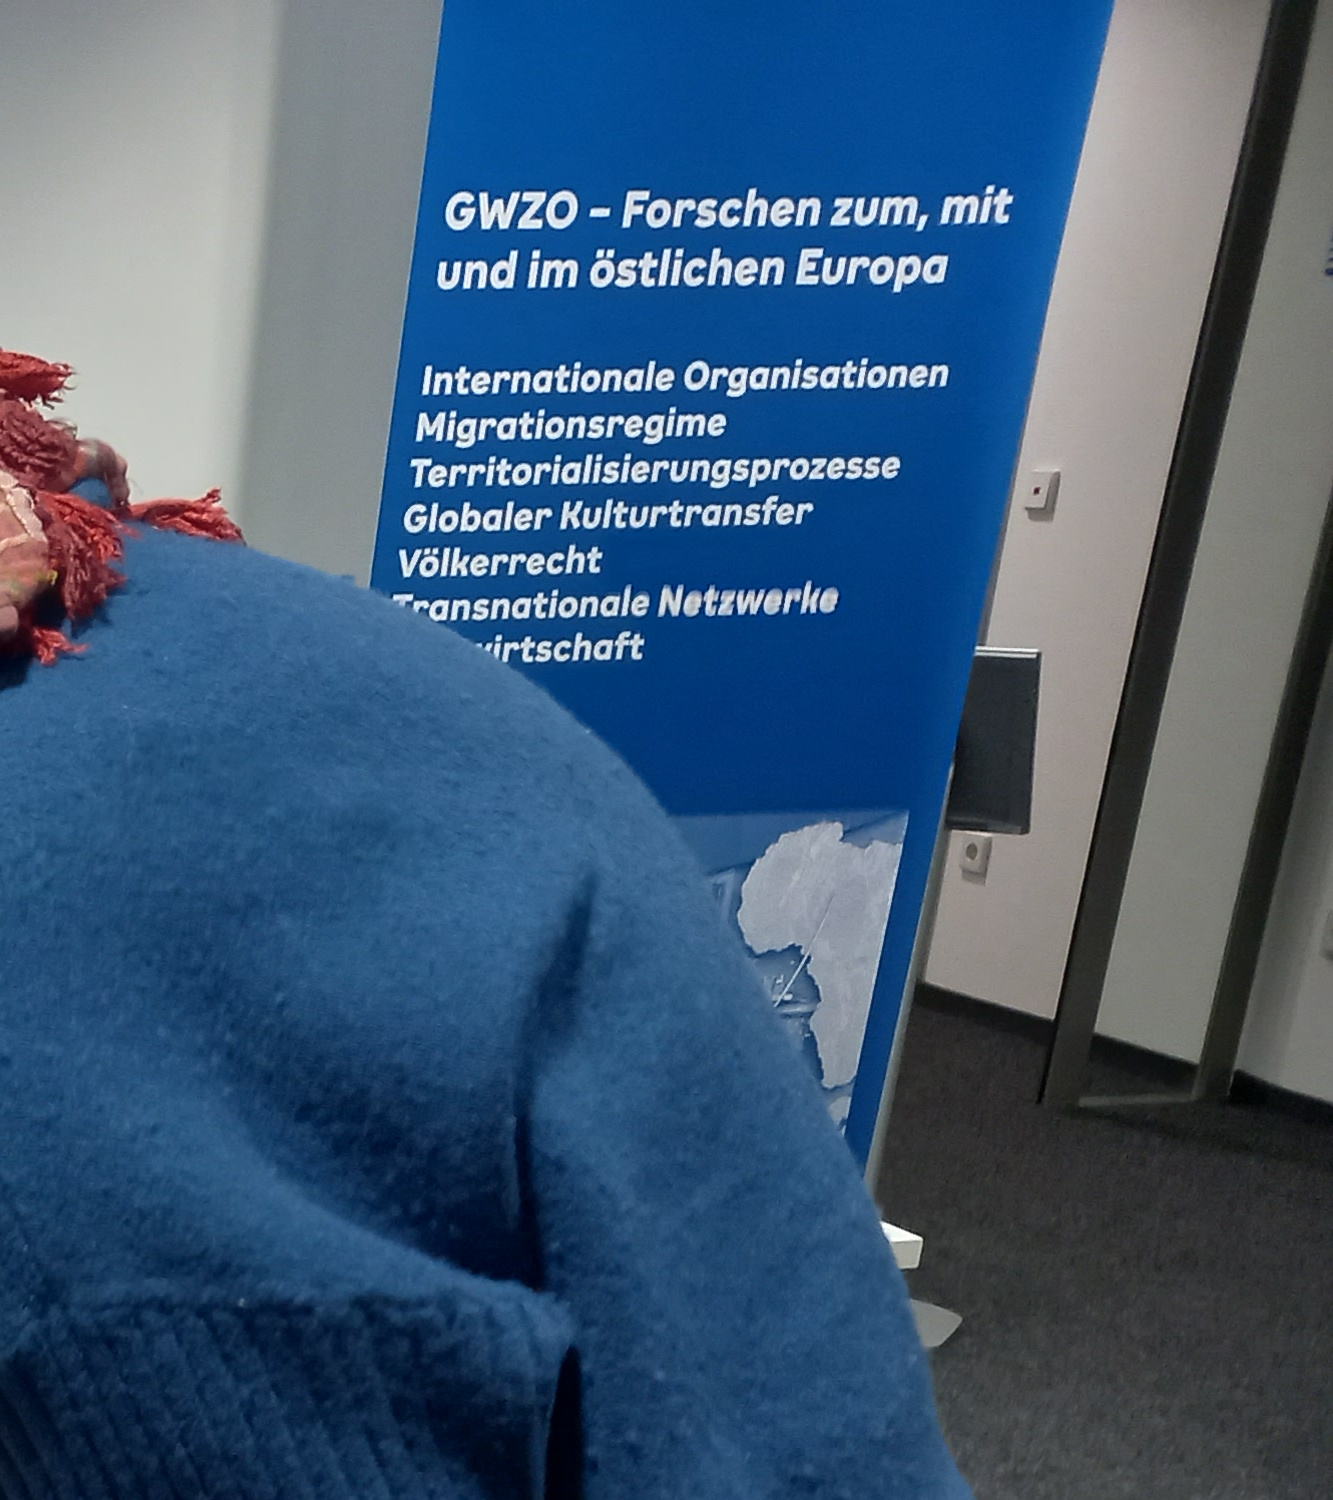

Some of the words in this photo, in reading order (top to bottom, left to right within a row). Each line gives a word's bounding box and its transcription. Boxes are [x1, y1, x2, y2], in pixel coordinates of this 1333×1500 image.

[445, 190, 578, 231] GWZO
[622, 187, 821, 228] Forschen
[831, 197, 929, 232] zum,
[940, 185, 1013, 225] mit
[436, 250, 515, 290] und
[528, 247, 578, 288] im
[589, 246, 785, 287] östlichen
[795, 247, 949, 293] Europa
[421, 361, 674, 396] Internationale
[685, 358, 950, 398] Organisationen
[415, 407, 727, 449] Migrationsregime
[410, 453, 901, 490] Territorialisierungsprozesse
[403, 502, 552, 534] Globaler
[560, 497, 814, 531] Kulturtransfer
[398, 545, 603, 579] Völkerrecht
[656, 580, 840, 617] Netzwerke
